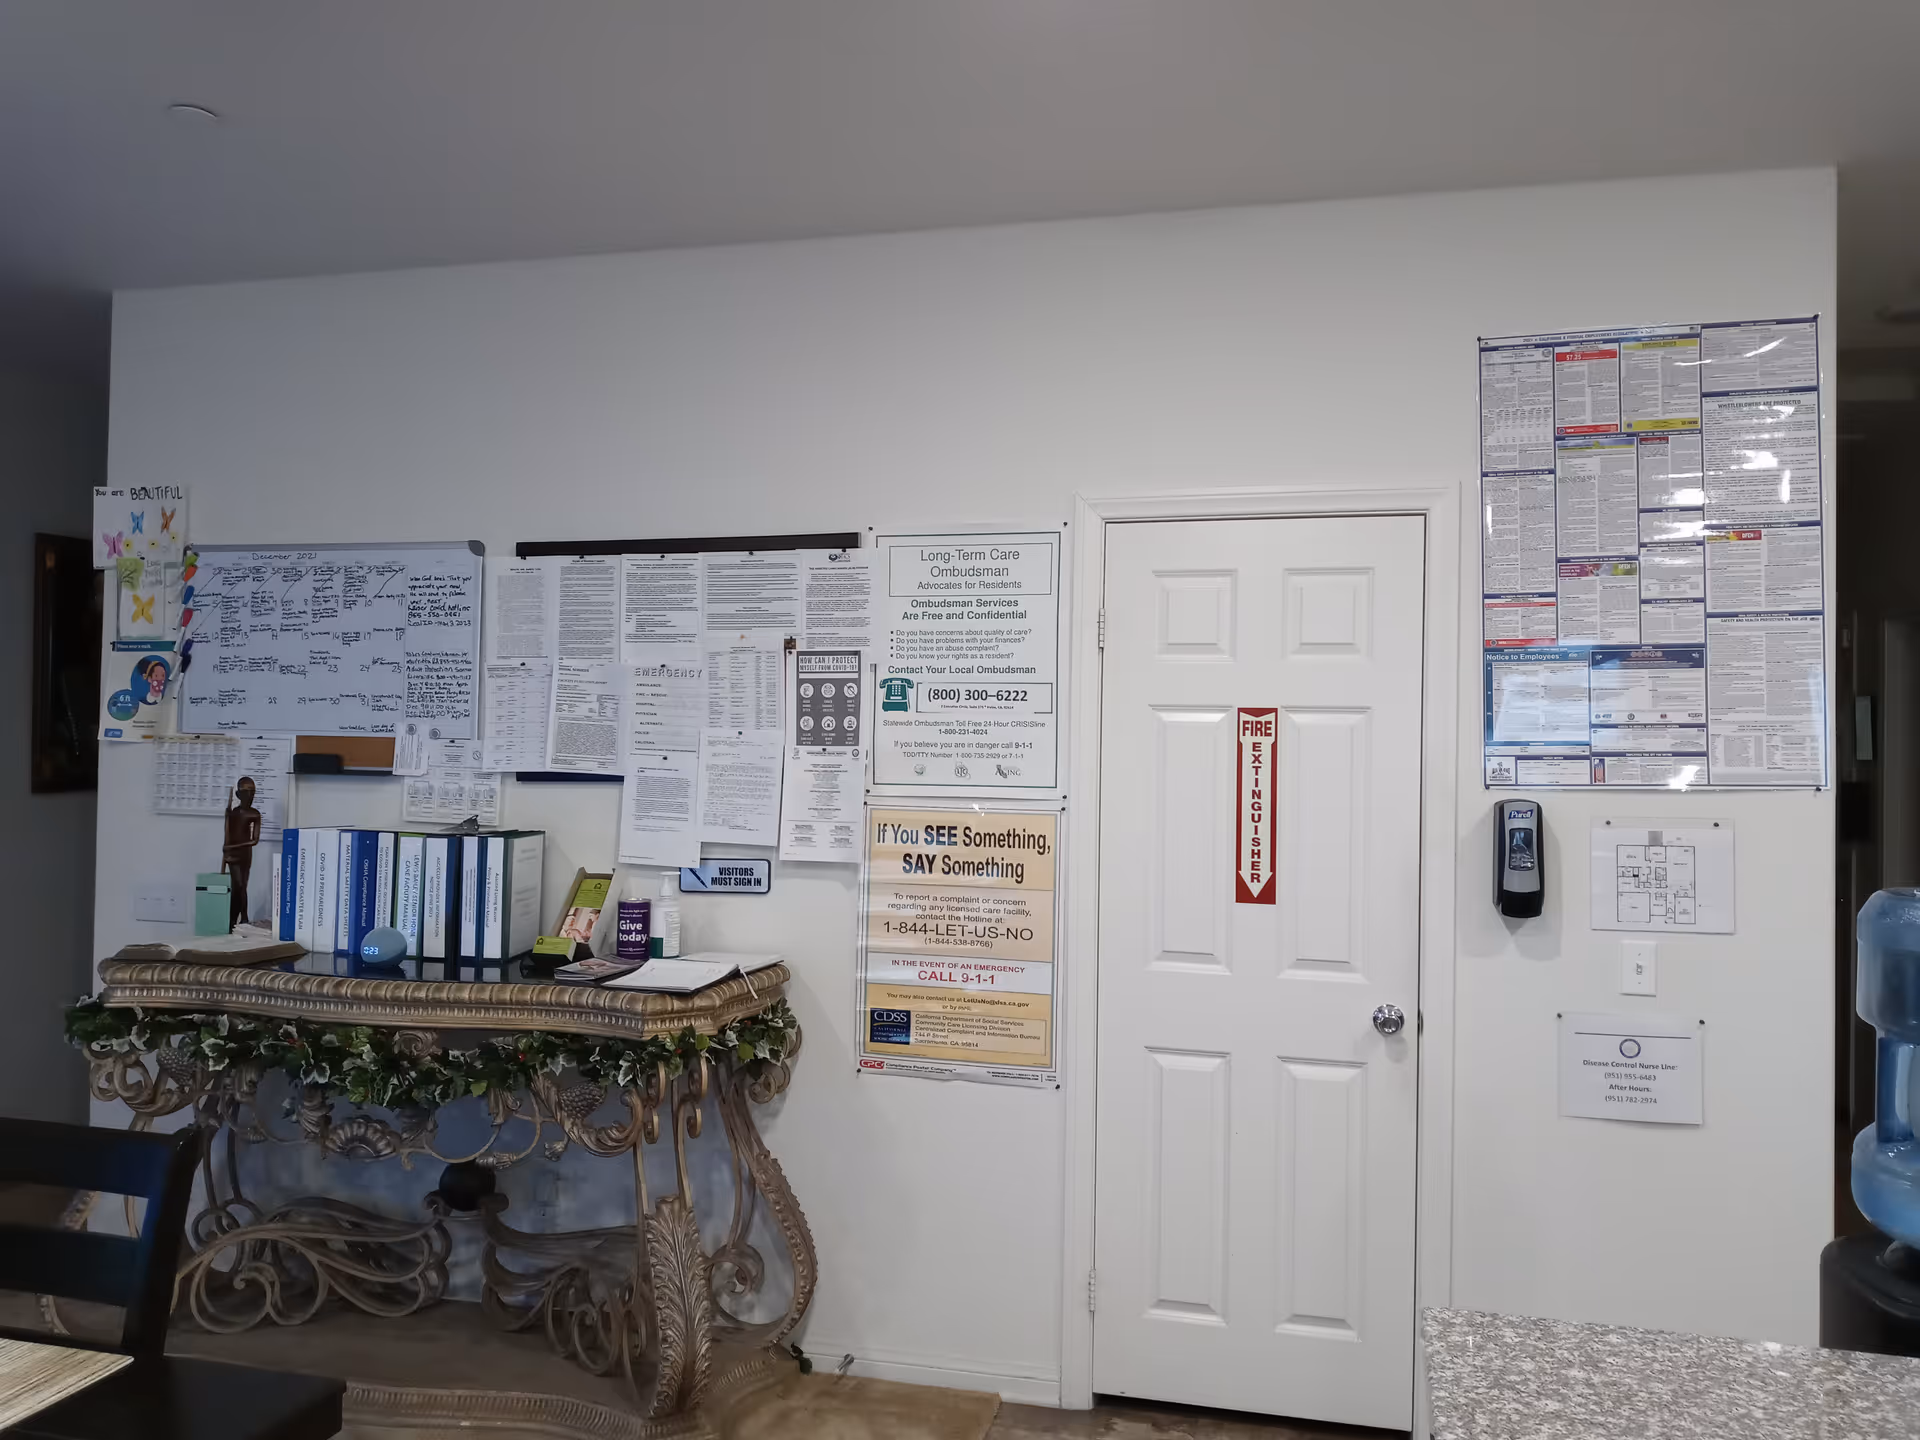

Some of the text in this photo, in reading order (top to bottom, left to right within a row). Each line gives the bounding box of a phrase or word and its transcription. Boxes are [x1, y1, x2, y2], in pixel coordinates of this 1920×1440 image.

[130, 486, 182, 500] BEAUTIFUL
[920, 548, 1020, 563] Long-Term Care
[930, 565, 1009, 577] Ombudsman
[917, 580, 1022, 590] Advocates for Residents
[911, 598, 1018, 608] Ombudsman Services
[902, 610, 1026, 620] Are Free and Confidential
[635, 668, 702, 678] EMERGENCY
[888, 666, 923, 674] Contact
[977, 666, 1036, 674] Ombudsman
[928, 688, 961, 703] (800)
[1242, 720, 1272, 737] FIRE
[1251, 742, 1263, 883] EXTINGUISHER
[877, 823, 1051, 855] If You SEE Something,
[719, 867, 754, 876] VISITORS
[902, 853, 1024, 884] SAY Something
[711, 877, 761, 886] MUST SIGN IN
[906, 894, 930, 902] report
[940, 895, 980, 904] complaint
[888, 902, 926, 911] regarding
[946, 905, 980, 913] licensed
[1003, 907, 1032, 917] facility,
[620, 920, 642, 930] Give
[883, 921, 1034, 941] 1-844-LET-US-NO
[619, 932, 648, 943] today.
[924, 938, 993, 948] (1-844-538-8766)
[974, 964, 1025, 974] EMERGENCY
[918, 970, 995, 984] CALL 9-1-1
[874, 1011, 907, 1022] CDSS
[1611, 1061, 1637, 1069] Control
[1628, 1085, 1652, 1093] Hours:
